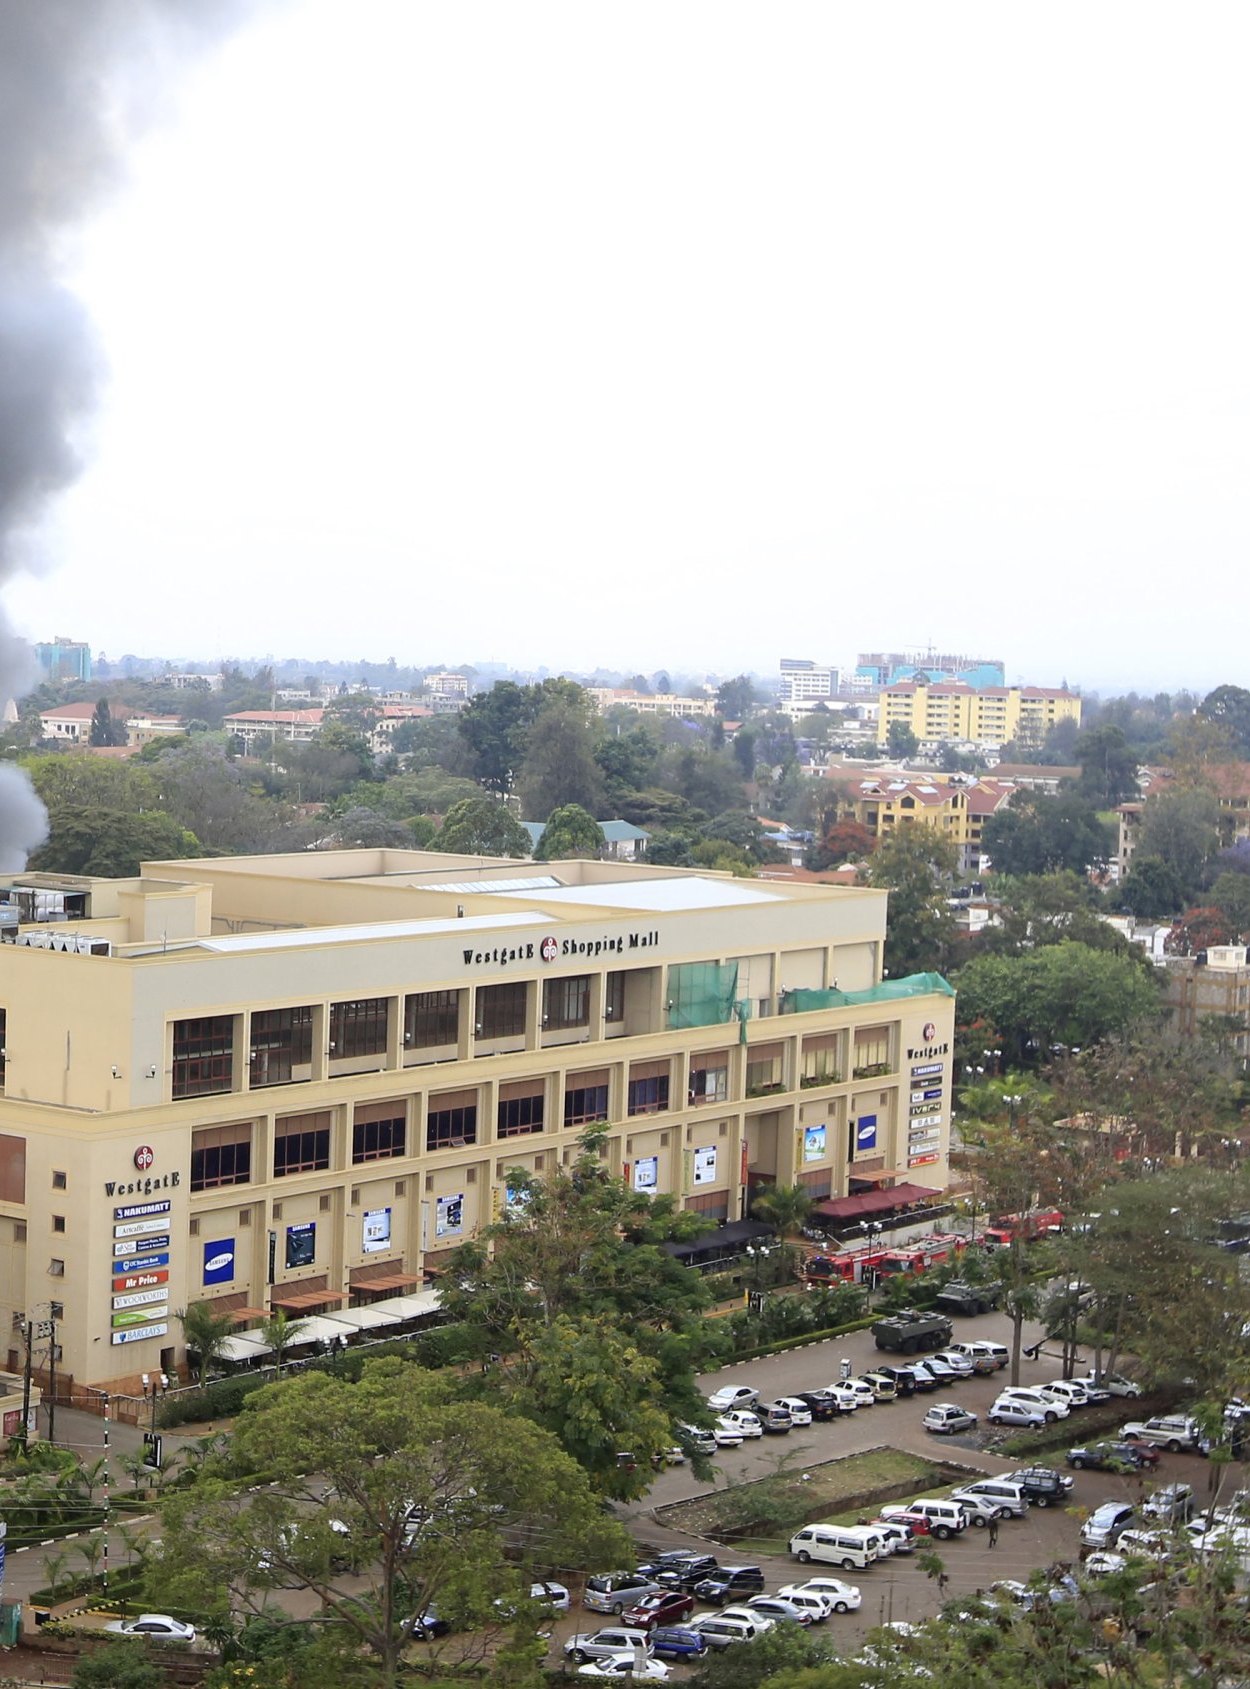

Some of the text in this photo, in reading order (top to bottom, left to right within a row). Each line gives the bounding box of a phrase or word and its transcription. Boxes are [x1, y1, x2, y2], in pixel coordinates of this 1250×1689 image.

[562, 936, 623, 956] Shopping
[628, 931, 659, 948] Mall
[123, 1202, 169, 1217] NAKUMATT
[125, 1275, 158, 1288] Mr Price
[122, 1290, 168, 1304] WOOLWORTHS
[127, 1326, 161, 1340] BARCLAYS
